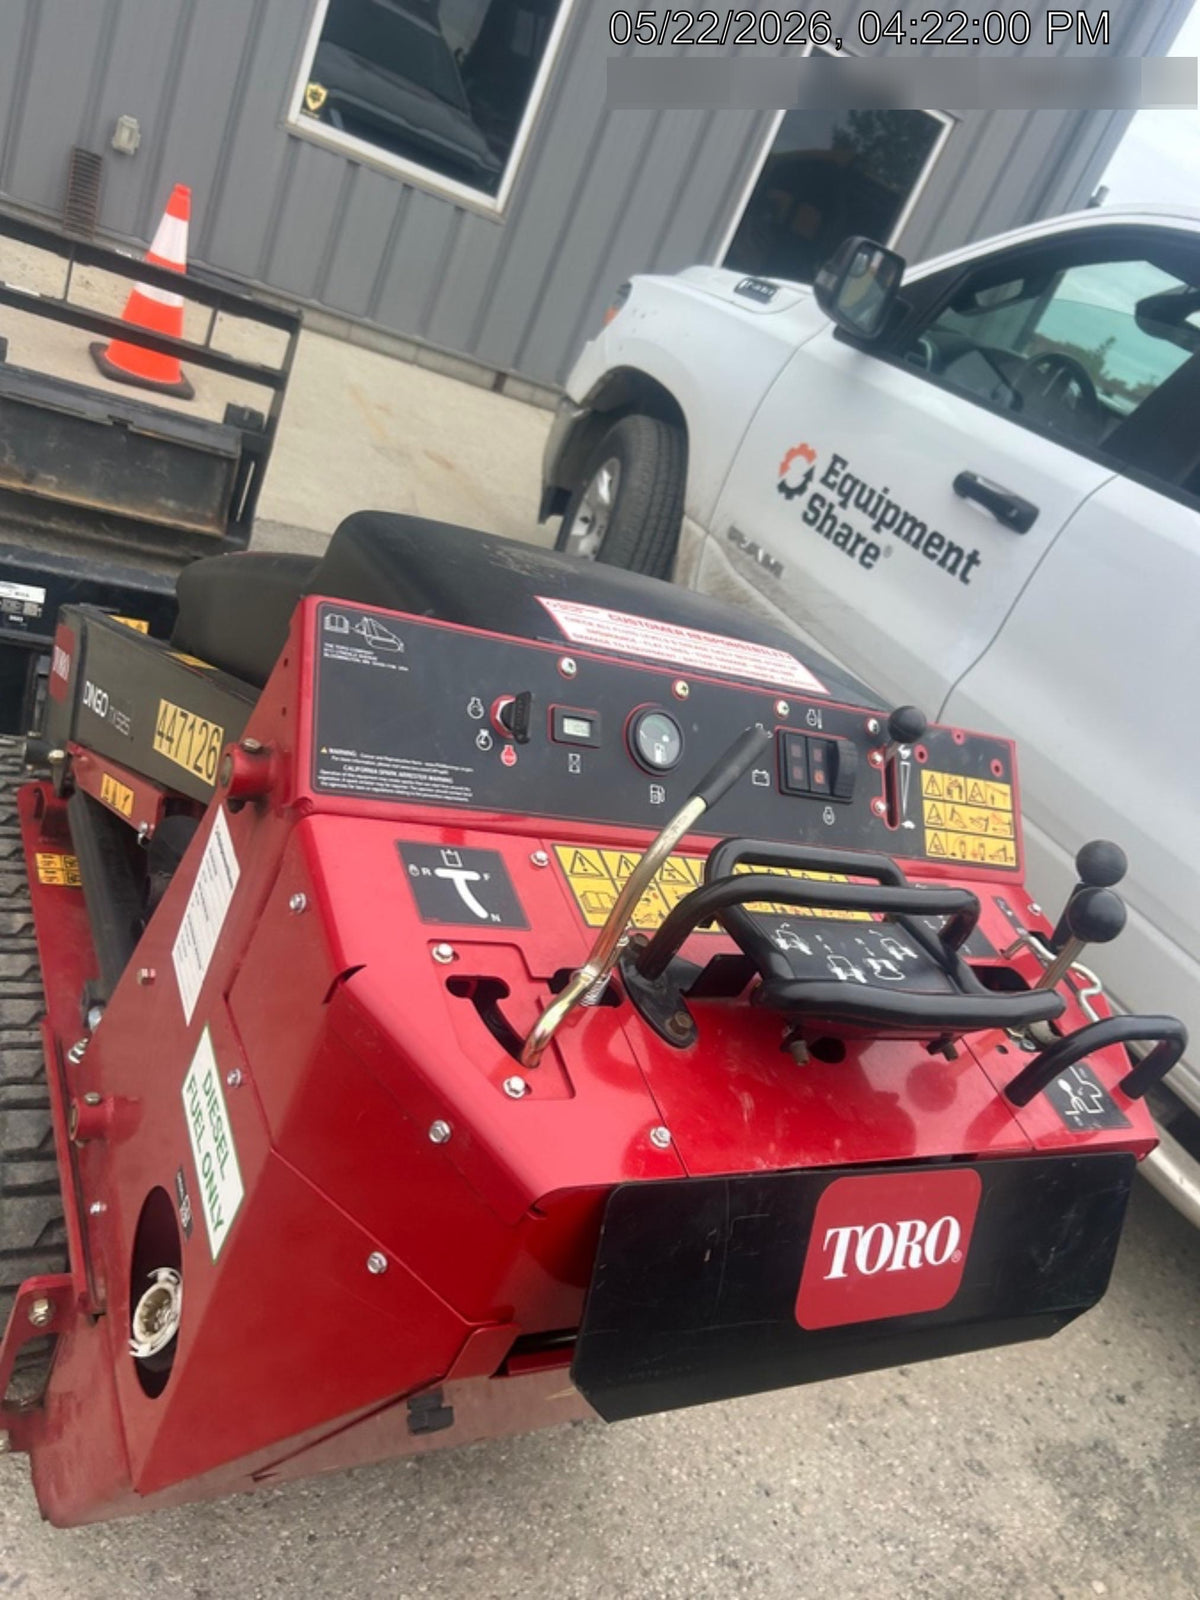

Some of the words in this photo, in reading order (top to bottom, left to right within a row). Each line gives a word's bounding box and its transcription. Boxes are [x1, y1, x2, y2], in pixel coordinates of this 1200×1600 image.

[802, 492, 881, 570] Share
[819, 453, 982, 585] Equipment
[156, 703, 222, 781] 447126
[421, 866, 433, 877] R
[490, 912, 502, 923] N
[186, 1073, 206, 1154] FUEL
[202, 1151, 225, 1233] ONLY
[202, 1068, 230, 1181] DIESEL
[822, 1215, 961, 1280] TORO
